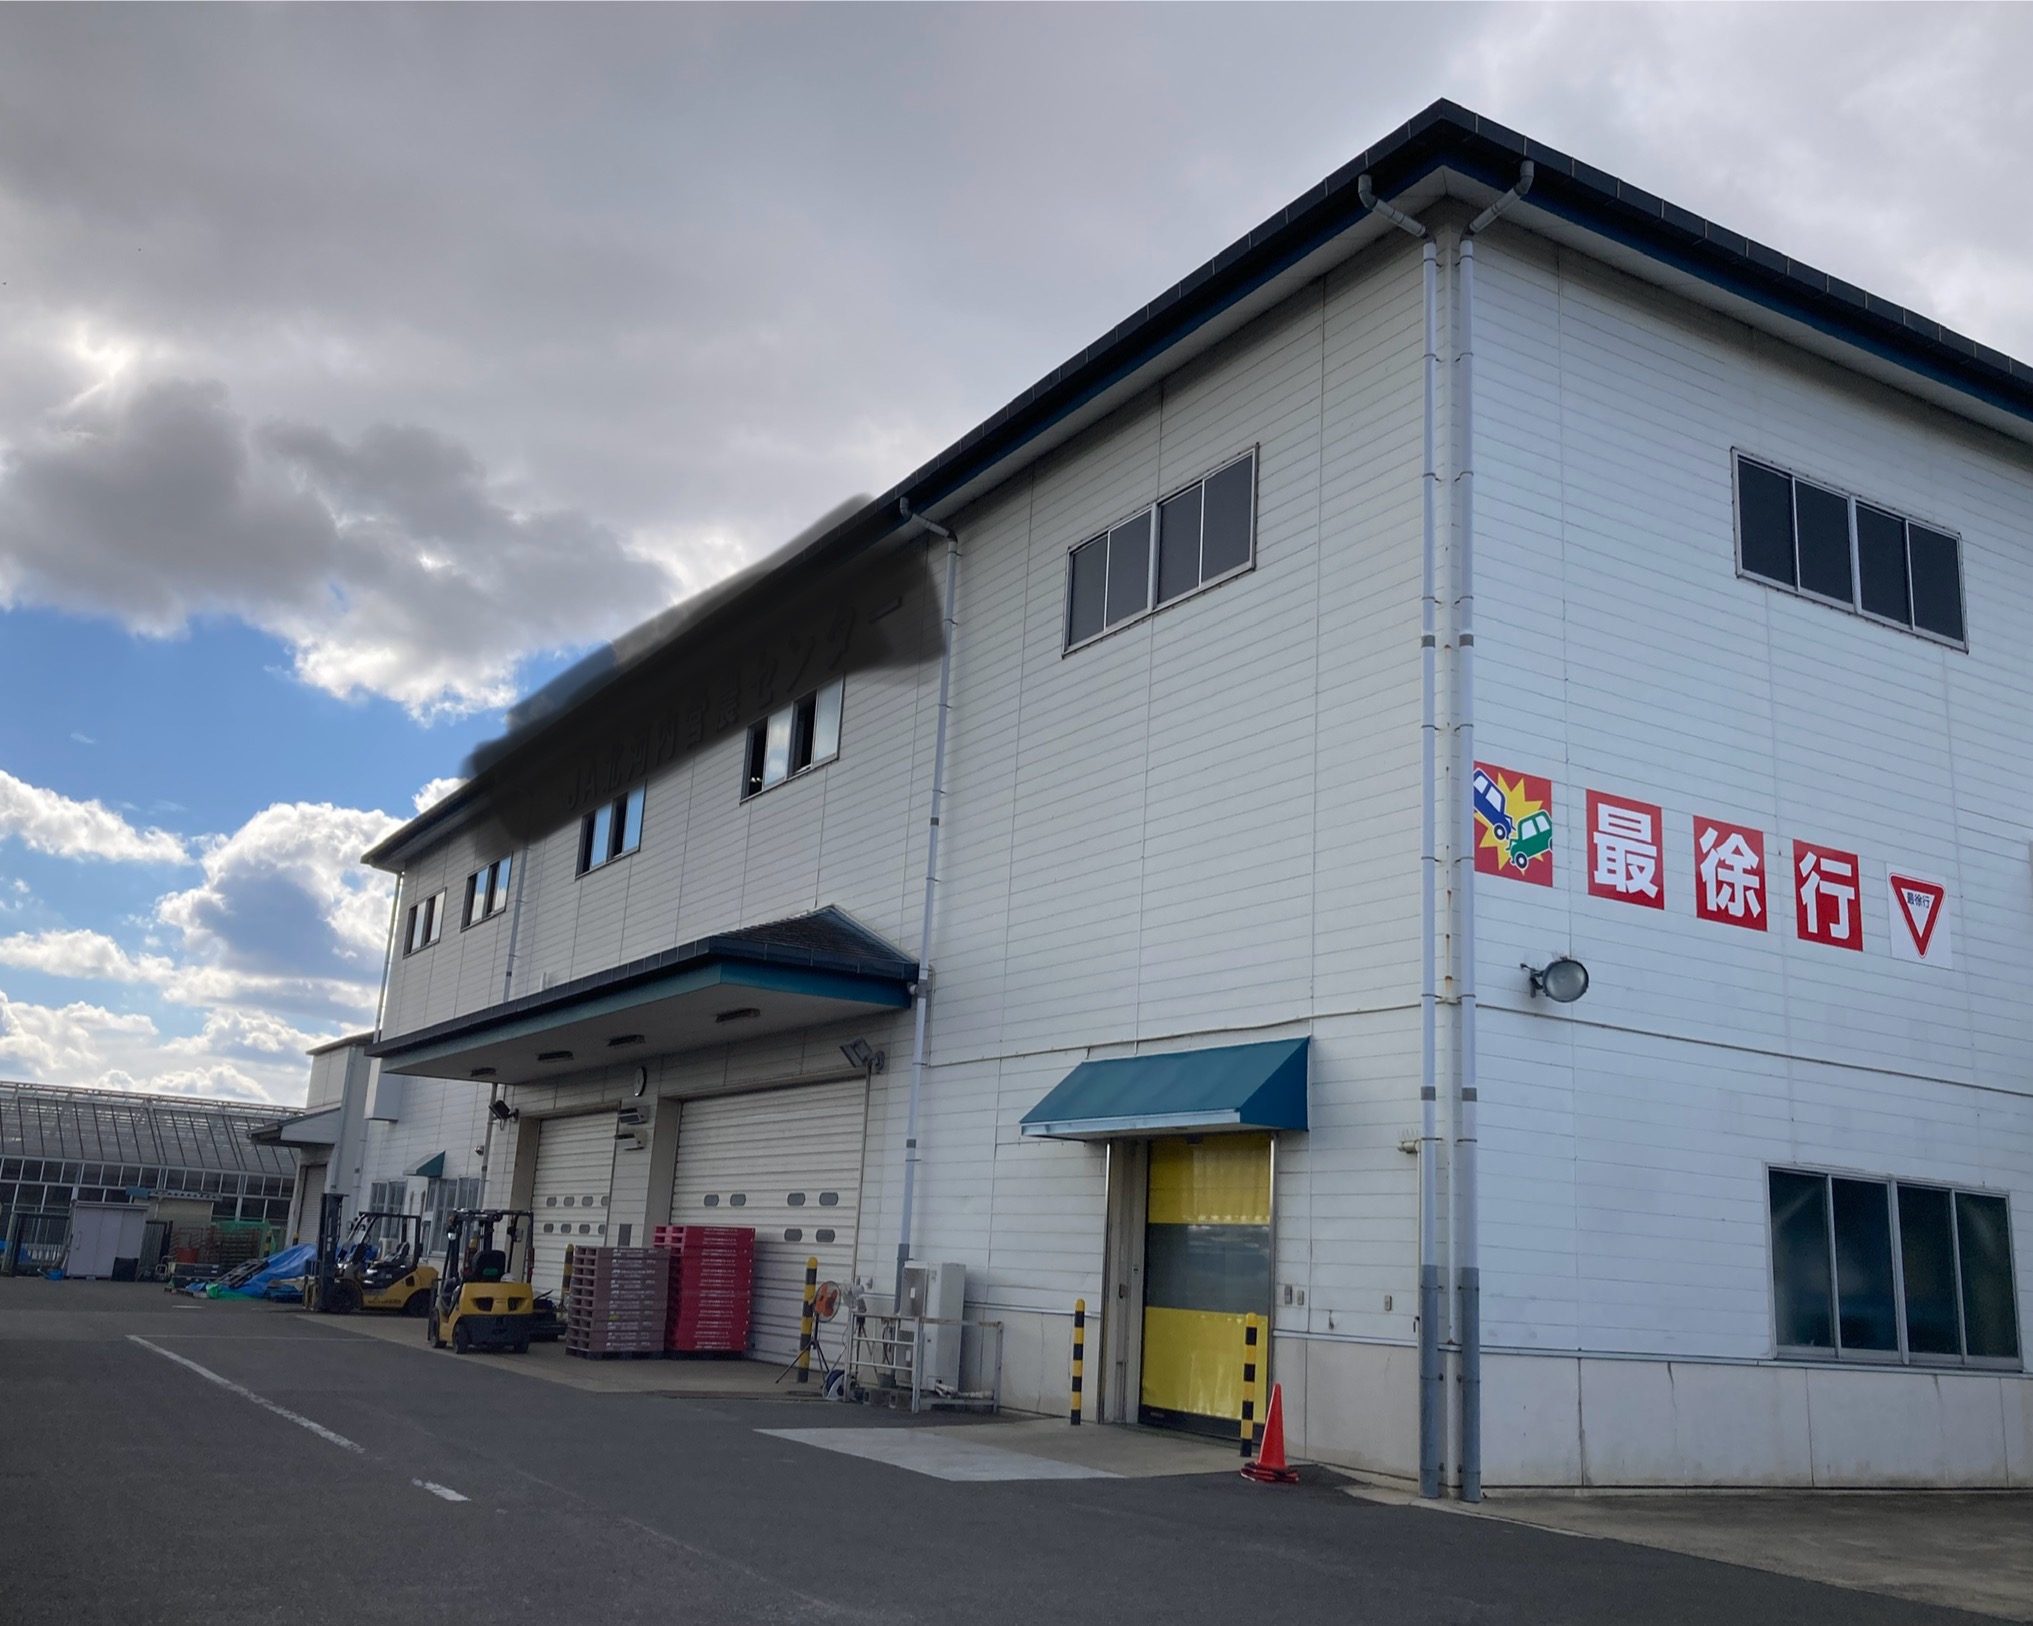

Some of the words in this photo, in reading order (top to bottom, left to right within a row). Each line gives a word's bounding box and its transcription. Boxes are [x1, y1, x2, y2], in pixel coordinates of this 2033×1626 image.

[1593, 803, 1855, 940] 最徐行
[1907, 891, 1930, 909] 最徐行
